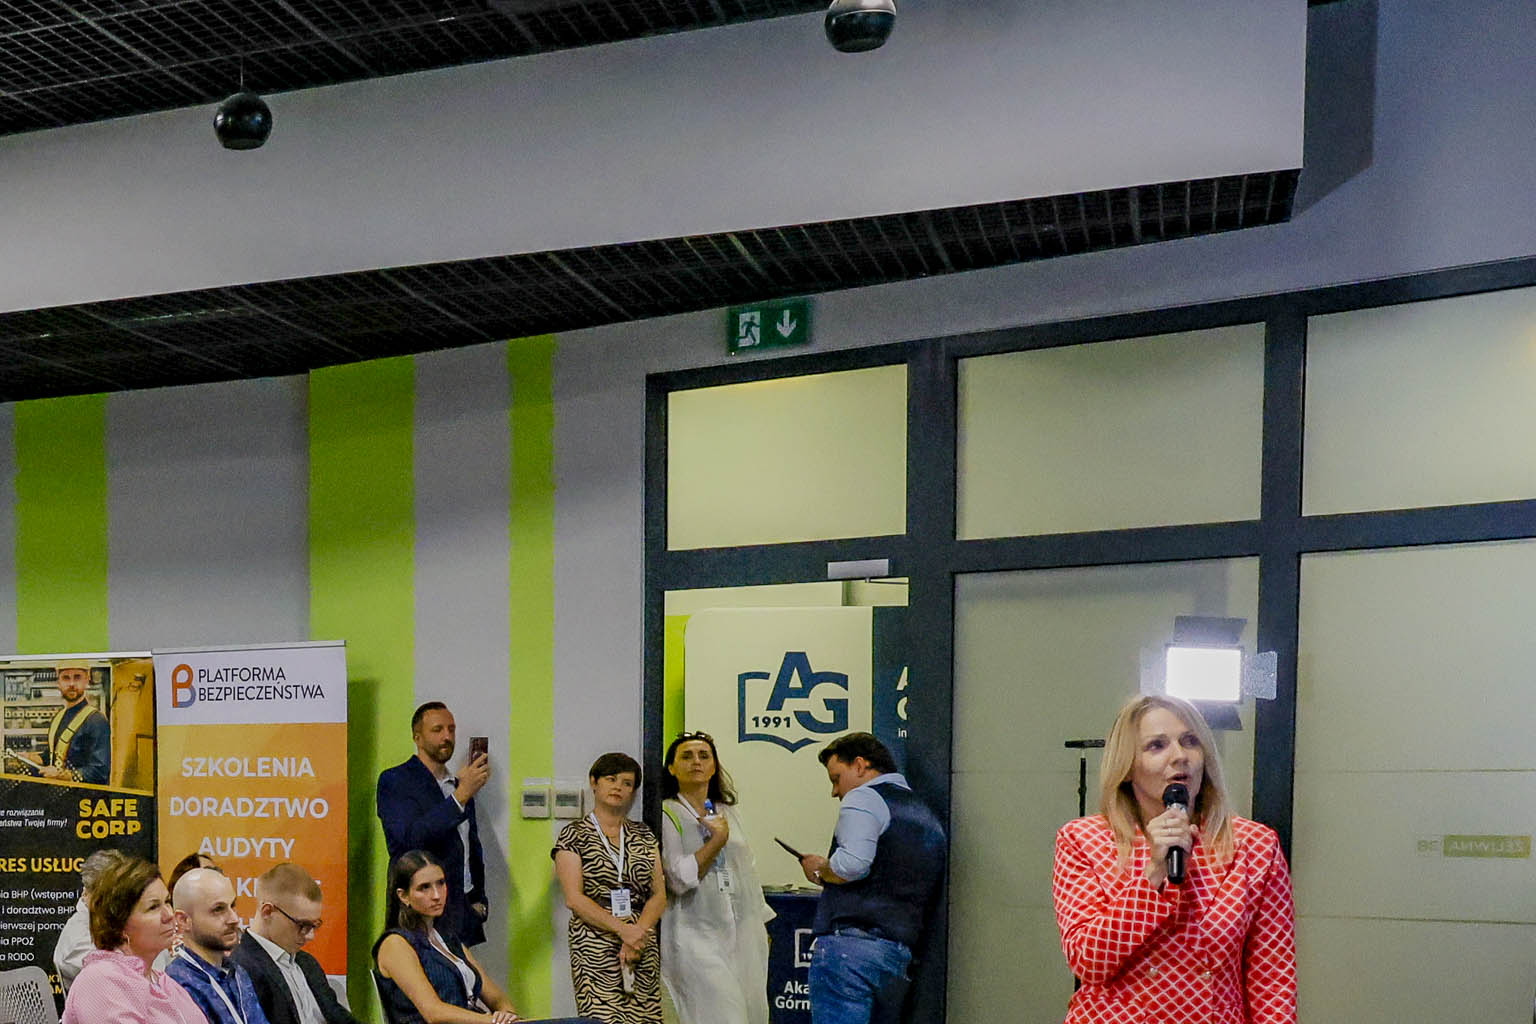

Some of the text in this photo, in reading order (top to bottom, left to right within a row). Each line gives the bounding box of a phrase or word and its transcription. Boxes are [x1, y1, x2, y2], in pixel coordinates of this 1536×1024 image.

[198, 666, 287, 684] PLATFORMA
[198, 681, 325, 702] BEZPIECZEŃSTWA
[751, 716, 791, 728] 1991
[181, 756, 316, 778] SZKOLENIA
[78, 798, 139, 818] SAFE
[169, 796, 330, 820] DORADZTWO
[24, 818, 46, 828] Twojej
[75, 819, 142, 840] CORP
[197, 836, 296, 859] AUDYTY
[11, 889, 29, 899] BHP
[6, 905, 56, 915] doradztwo
[7, 952, 35, 961] RODO
